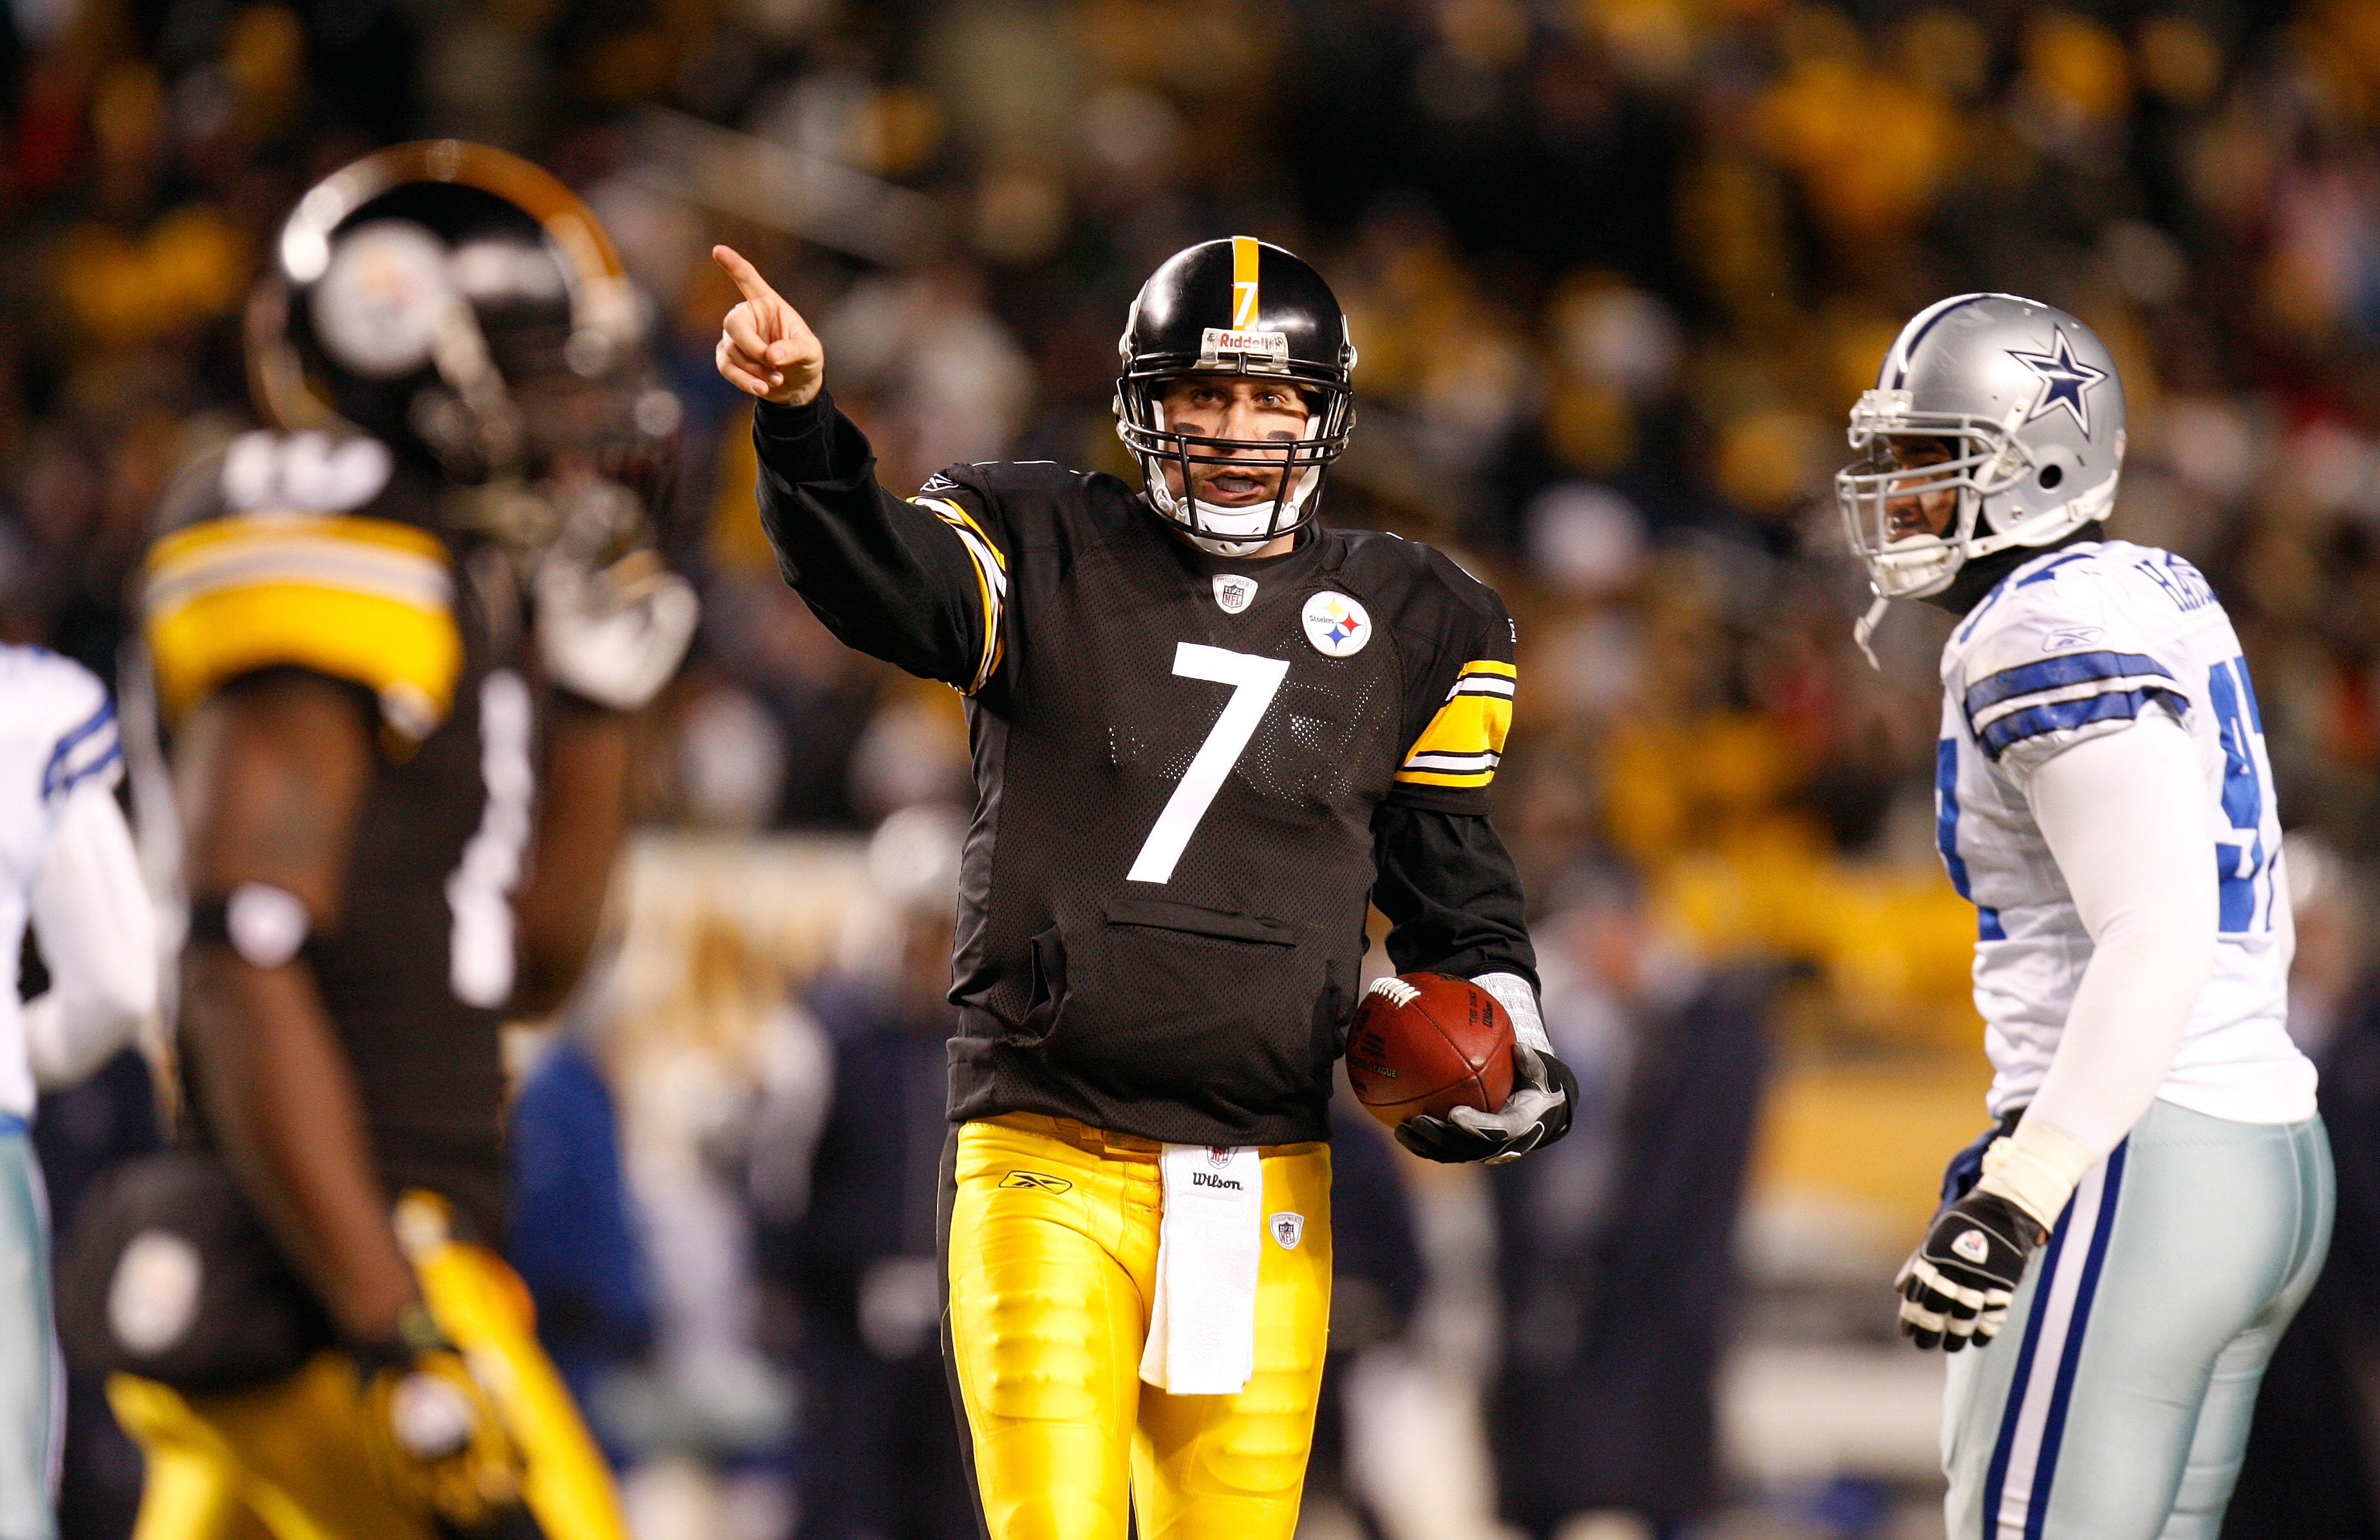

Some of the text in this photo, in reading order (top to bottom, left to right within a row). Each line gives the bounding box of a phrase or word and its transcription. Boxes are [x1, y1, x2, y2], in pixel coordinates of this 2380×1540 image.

[1234, 281, 1259, 326] 7
[1220, 333, 1268, 350] Riddell
[2132, 552, 2220, 612] HA
[1225, 594, 1242, 606] NFL
[1309, 615, 1335, 624] Steelers
[1126, 641, 1290, 885] 7
[1193, 1172, 1242, 1190] Wilson
[1280, 1231, 1294, 1243] NFL
